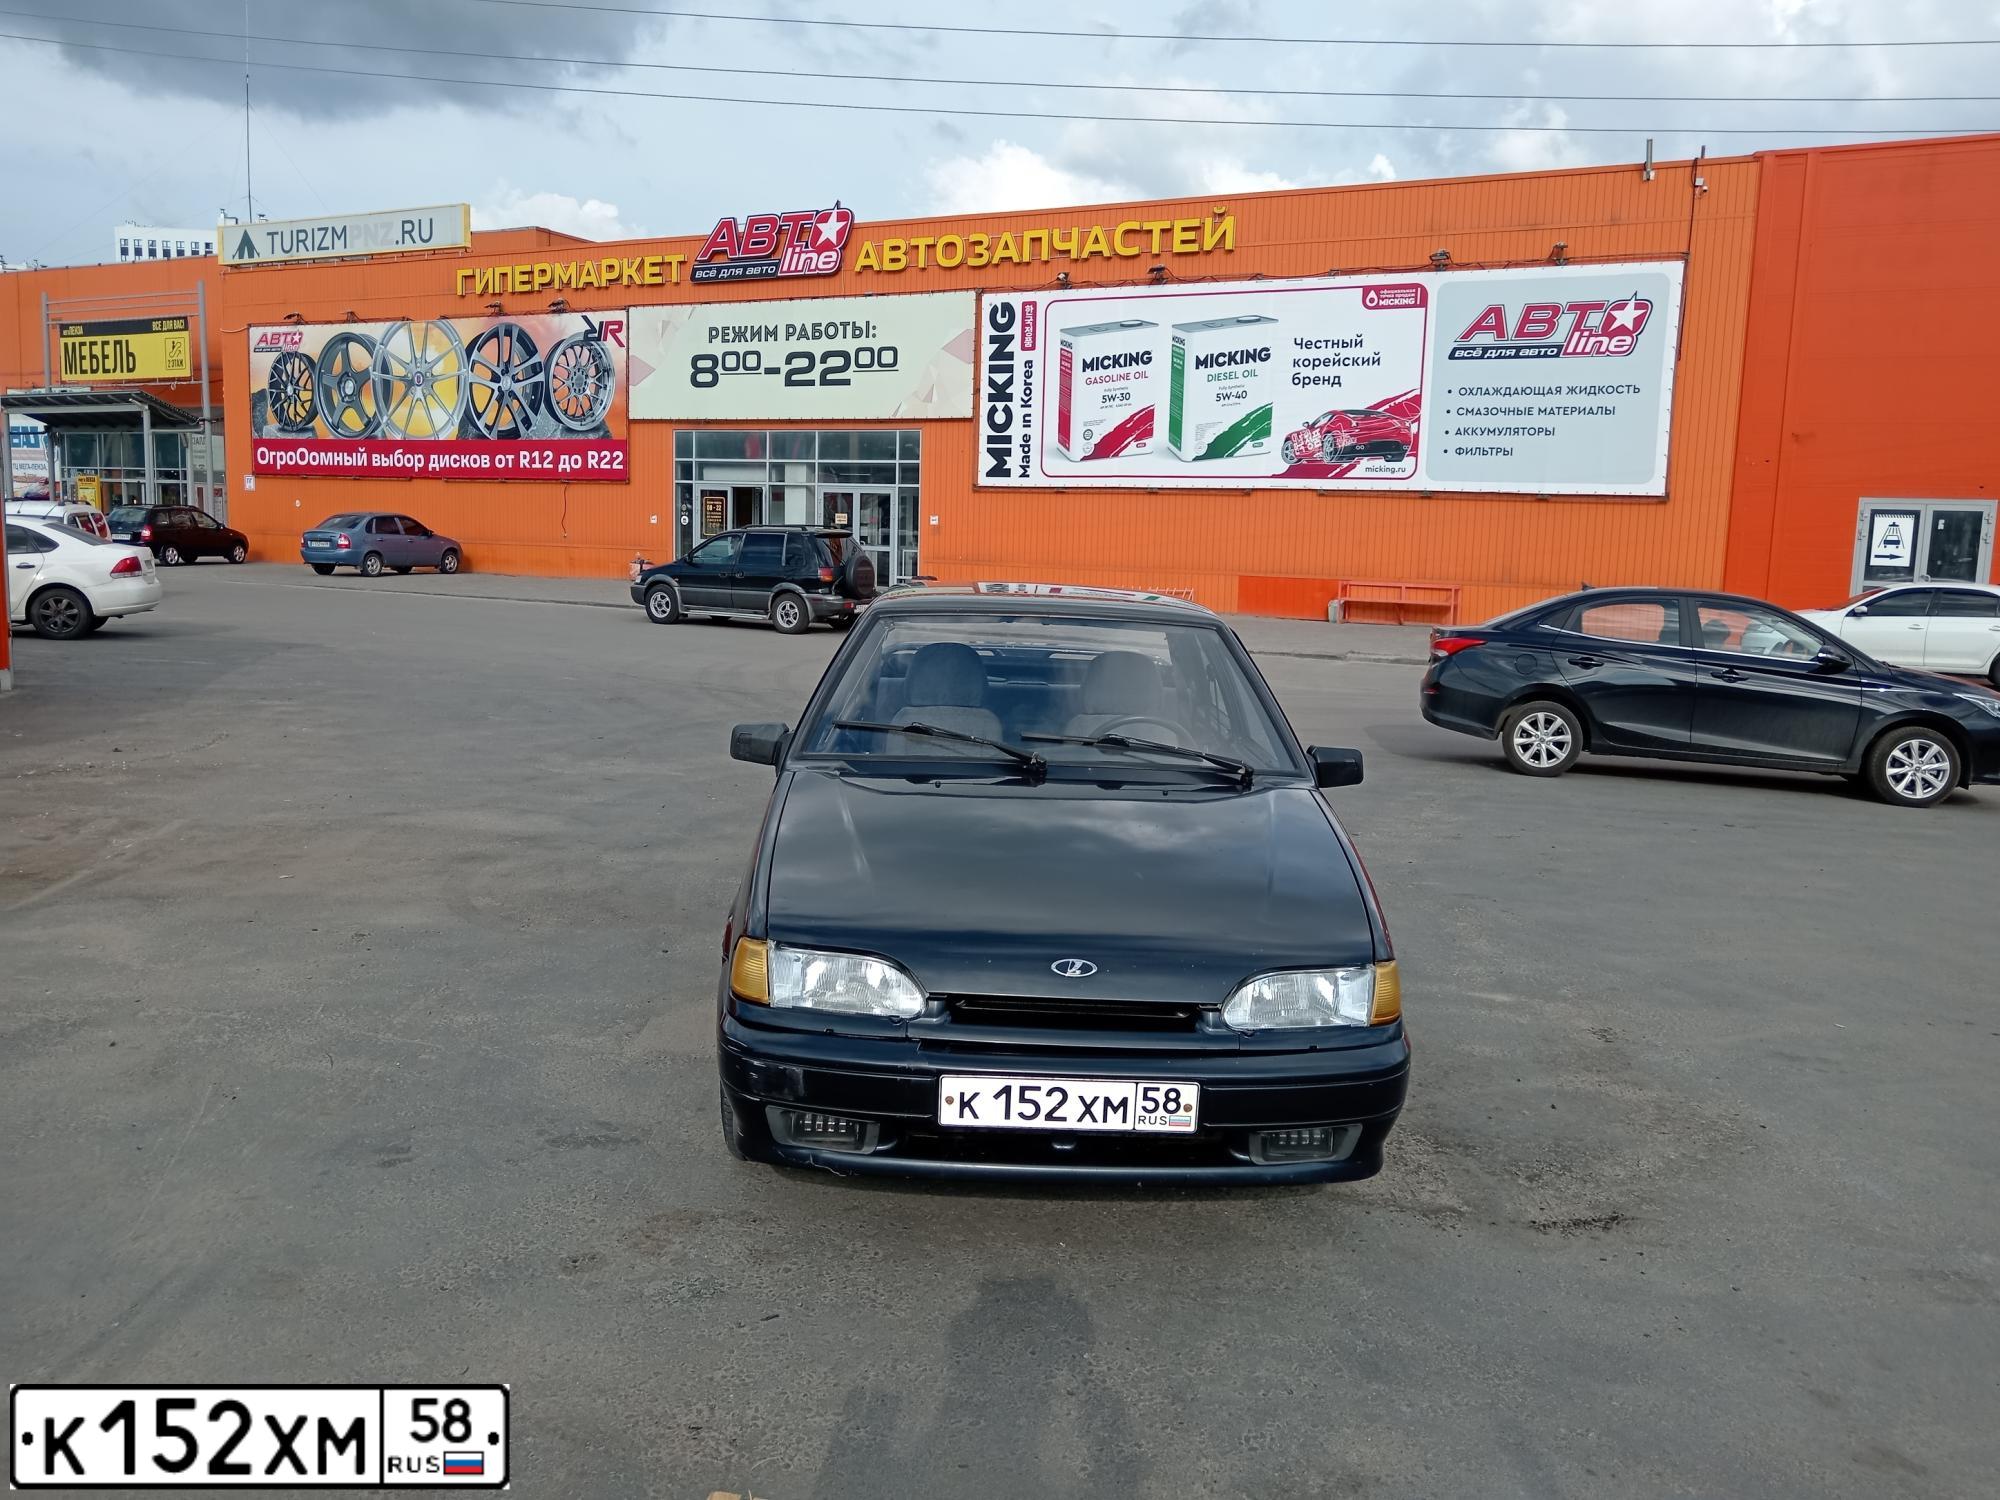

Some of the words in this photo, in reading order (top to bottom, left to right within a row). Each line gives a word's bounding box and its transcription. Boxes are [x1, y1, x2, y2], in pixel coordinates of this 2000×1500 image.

[854, 205, 1237, 273] АВТОЗАПЧАСТЕЙ
[782, 246, 837, 273] line
[456, 253, 687, 296] ГИПЕРМАРКЕТ
[695, 267, 717, 278] всё
[719, 266, 743, 278] для
[745, 265, 776, 275] авто
[1378, 297, 1416, 306] MICKING
[708, 324, 778, 344] РЕЖИМ
[785, 320, 877, 342] РАБОТЫ:
[1293, 333, 1364, 350] Честный
[1566, 331, 1633, 354] line
[63, 339, 137, 375] МЕБЕЛЬ
[1195, 346, 1271, 370] MICKING
[1292, 351, 1381, 371] корейский
[1454, 346, 1483, 358] всё
[1484, 348, 1516, 359] для
[1518, 347, 1558, 357] авто
[171, 359, 184, 368] ЭТАЖ
[1082, 350, 1153, 373] MICKING
[1020, 359, 1034, 408] Korea
[1085, 372, 1131, 386] GASOLINE
[1133, 370, 1149, 380] OIL
[1207, 372, 1240, 383] DIESEL
[1241, 369, 1258, 378] OIL
[1291, 372, 1342, 389] бренд
[985, 301, 1016, 478] MICKING
[1101, 392, 1131, 404] 5W-30
[1215, 390, 1248, 402] 5W-40
[1458, 386, 1563, 398] ОХЛАЖДАЮЩАЯ
[1566, 384, 1641, 397] ЖИДКОСТЬ
[1456, 407, 1535, 417] СМАЗОЧНЫЕ
[1537, 406, 1616, 416] МАТЕРИАЛЫ
[1022, 413, 1032, 428] in
[1454, 427, 1556, 437] АККУМУЛЯТОРЫ
[256, 445, 370, 470] ОгроОомный
[372, 448, 425, 472] выбор
[428, 453, 490, 472] дисков
[494, 454, 515, 469] от
[519, 450, 553, 470] R12
[558, 454, 583, 473] до
[587, 450, 624, 470] R22
[1018, 433, 1032, 478] Made
[1454, 446, 1514, 457] ФИЛЬТРЫ
[1365, 465, 1406, 474] micking.ru
[1141, 1086, 1181, 1115] 58
[1137, 1115, 1168, 1126] RUS
